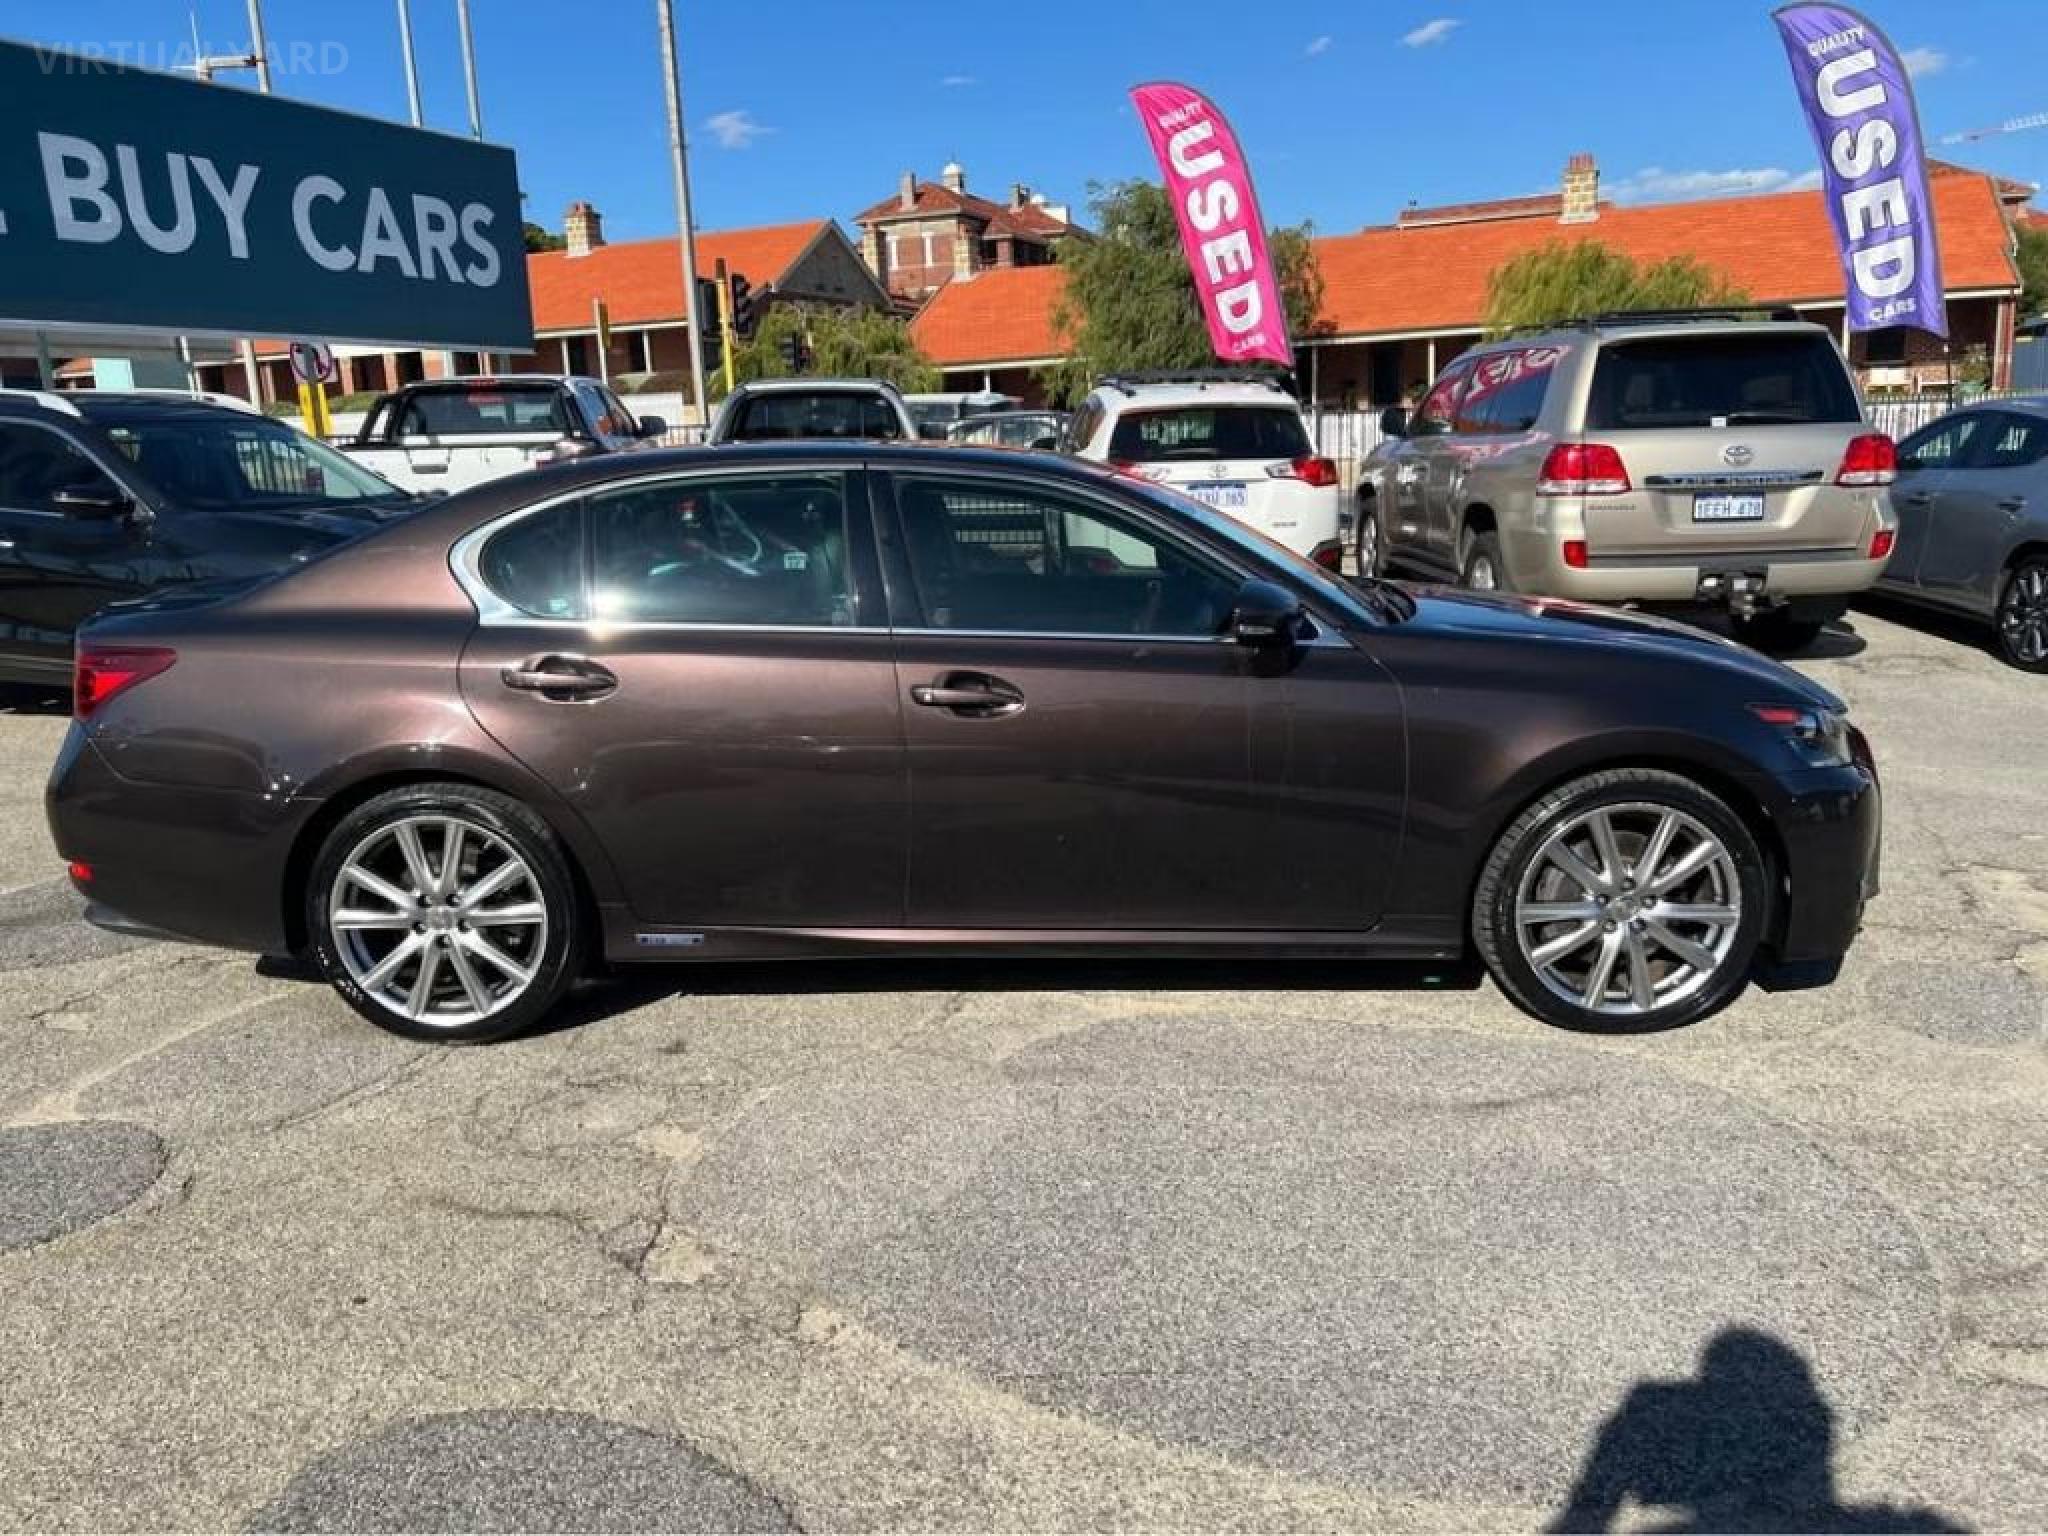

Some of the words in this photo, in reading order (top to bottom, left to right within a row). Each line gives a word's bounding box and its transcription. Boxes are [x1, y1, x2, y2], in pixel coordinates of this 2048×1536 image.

[37, 131, 260, 259] BUY
[292, 175, 500, 288] CARS
[1169, 120, 1263, 333] USED
[1817, 49, 1915, 298] USED
